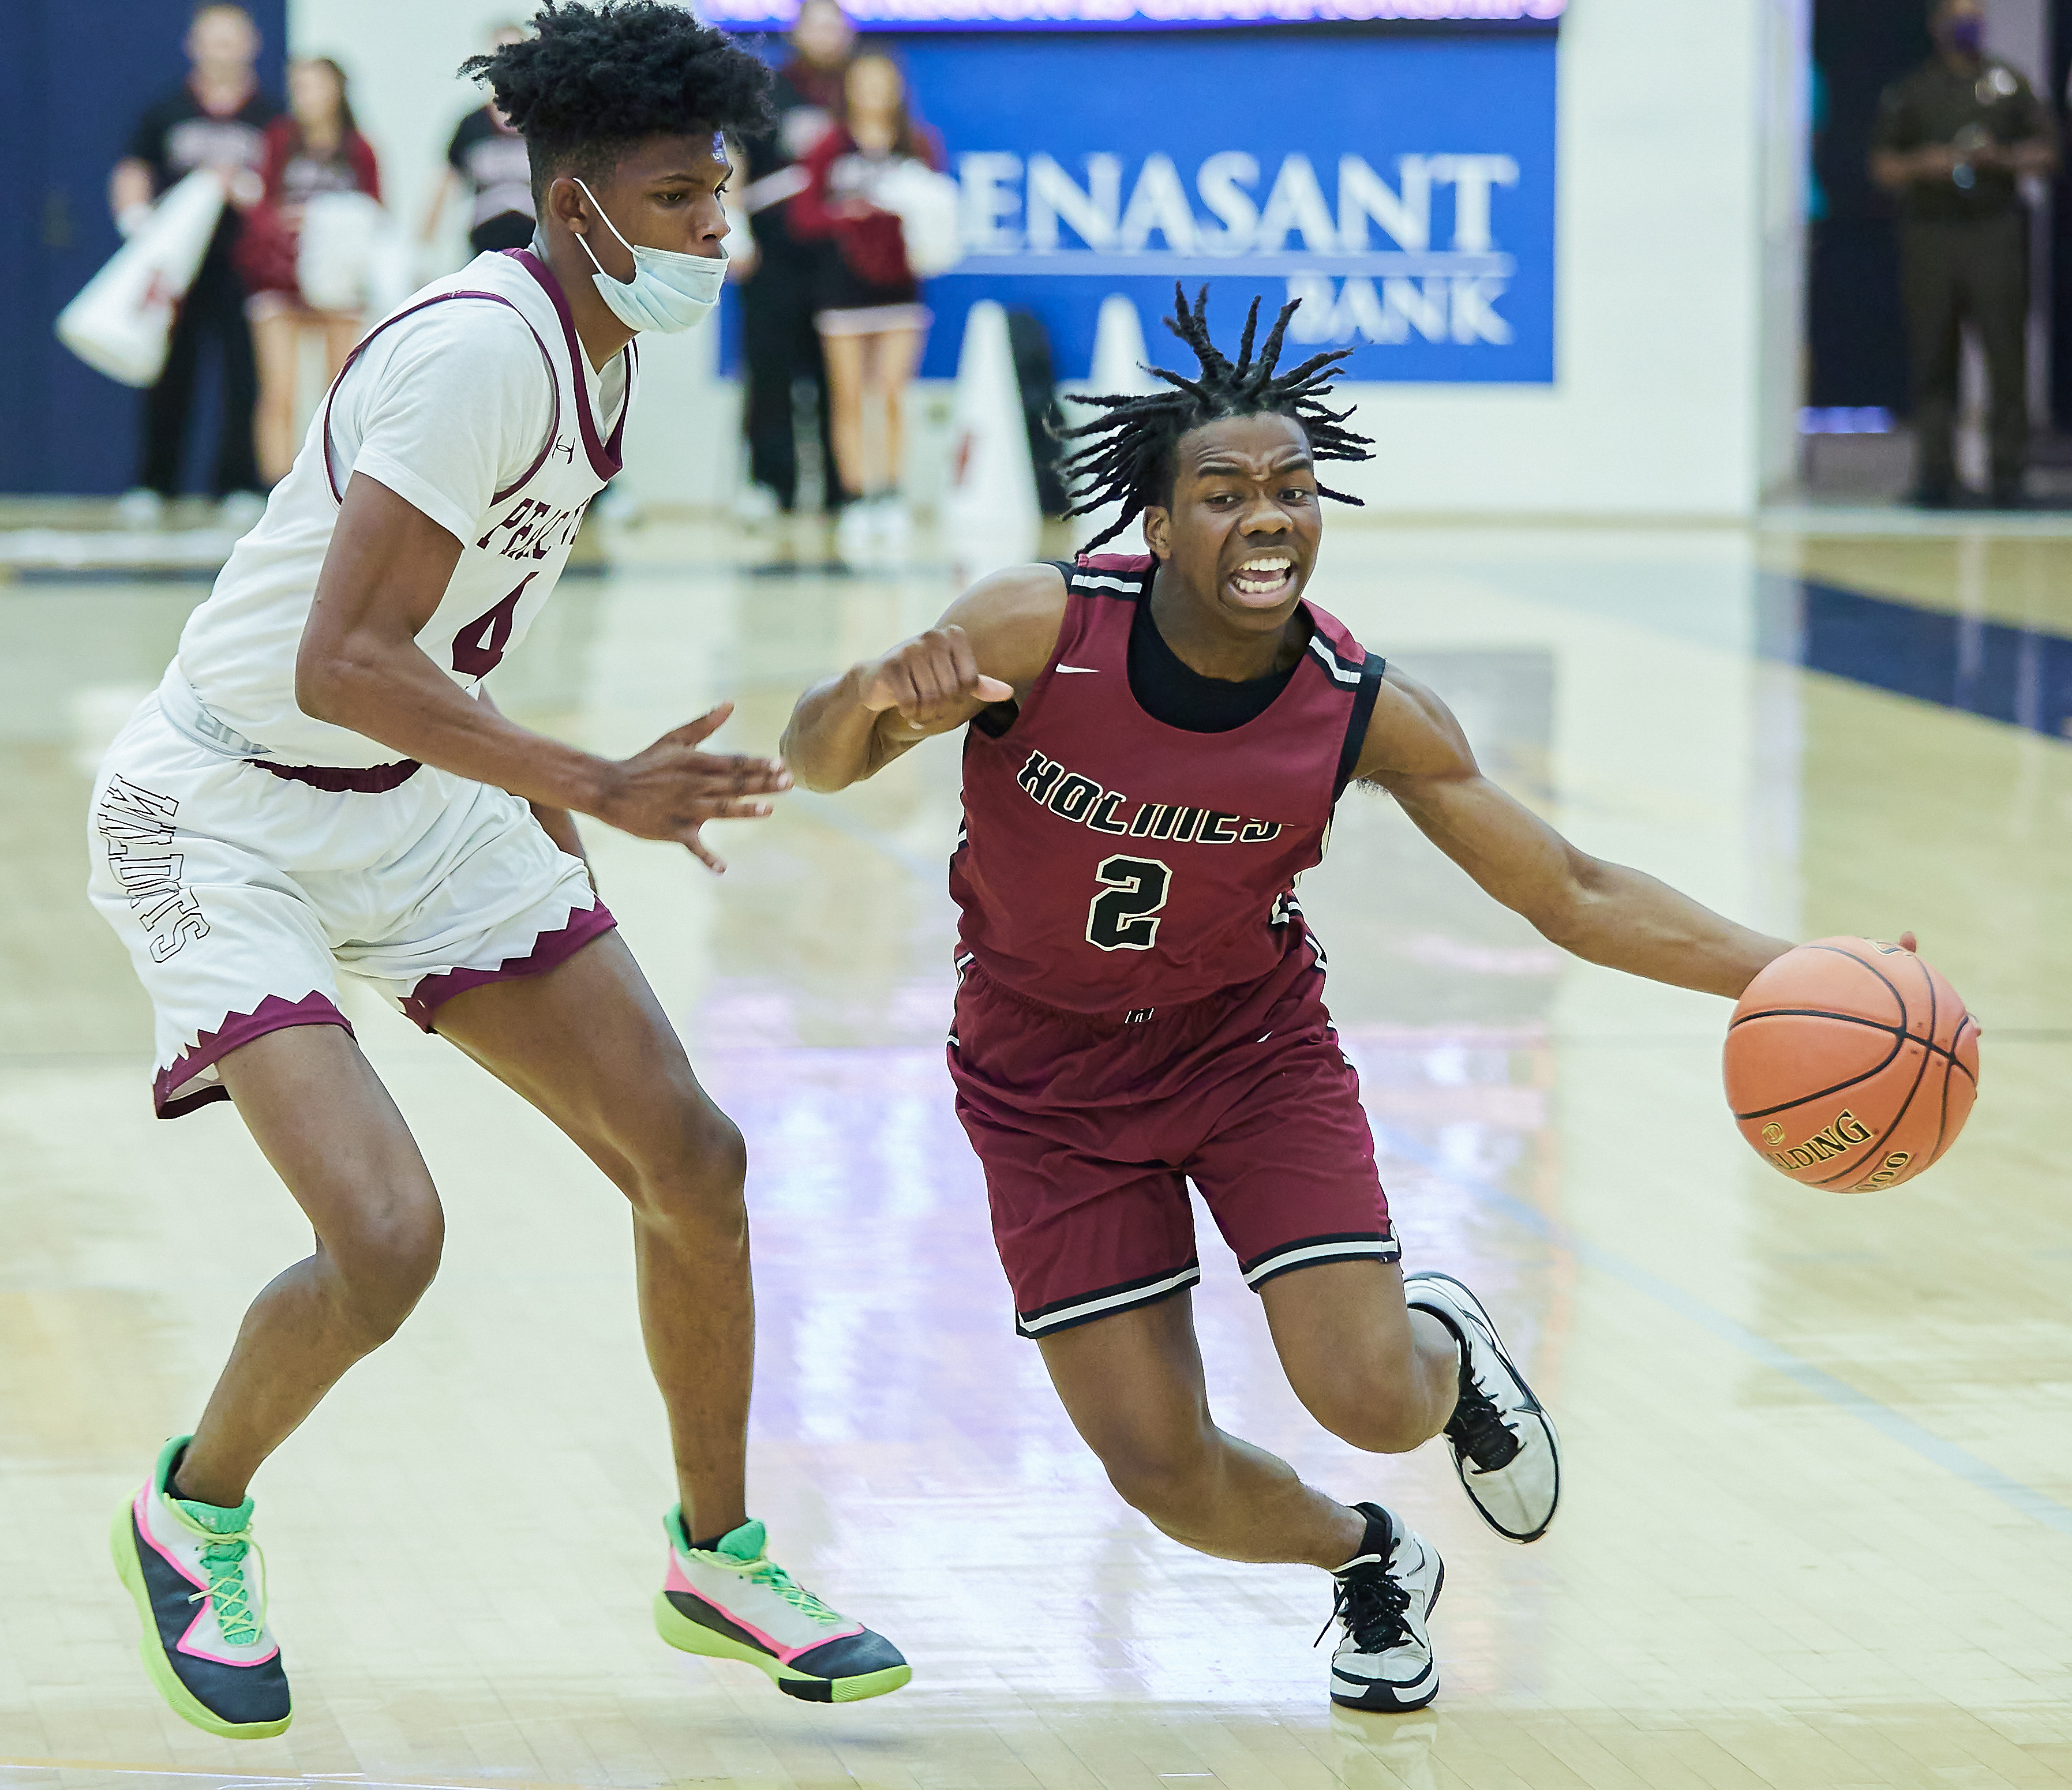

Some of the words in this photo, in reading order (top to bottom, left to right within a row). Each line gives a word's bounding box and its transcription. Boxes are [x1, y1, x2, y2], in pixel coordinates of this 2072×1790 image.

[959, 151, 1520, 258] ENASANT
[1284, 271, 1514, 346] BANK
[451, 570, 540, 691] 4
[1085, 854, 1173, 952] 2
